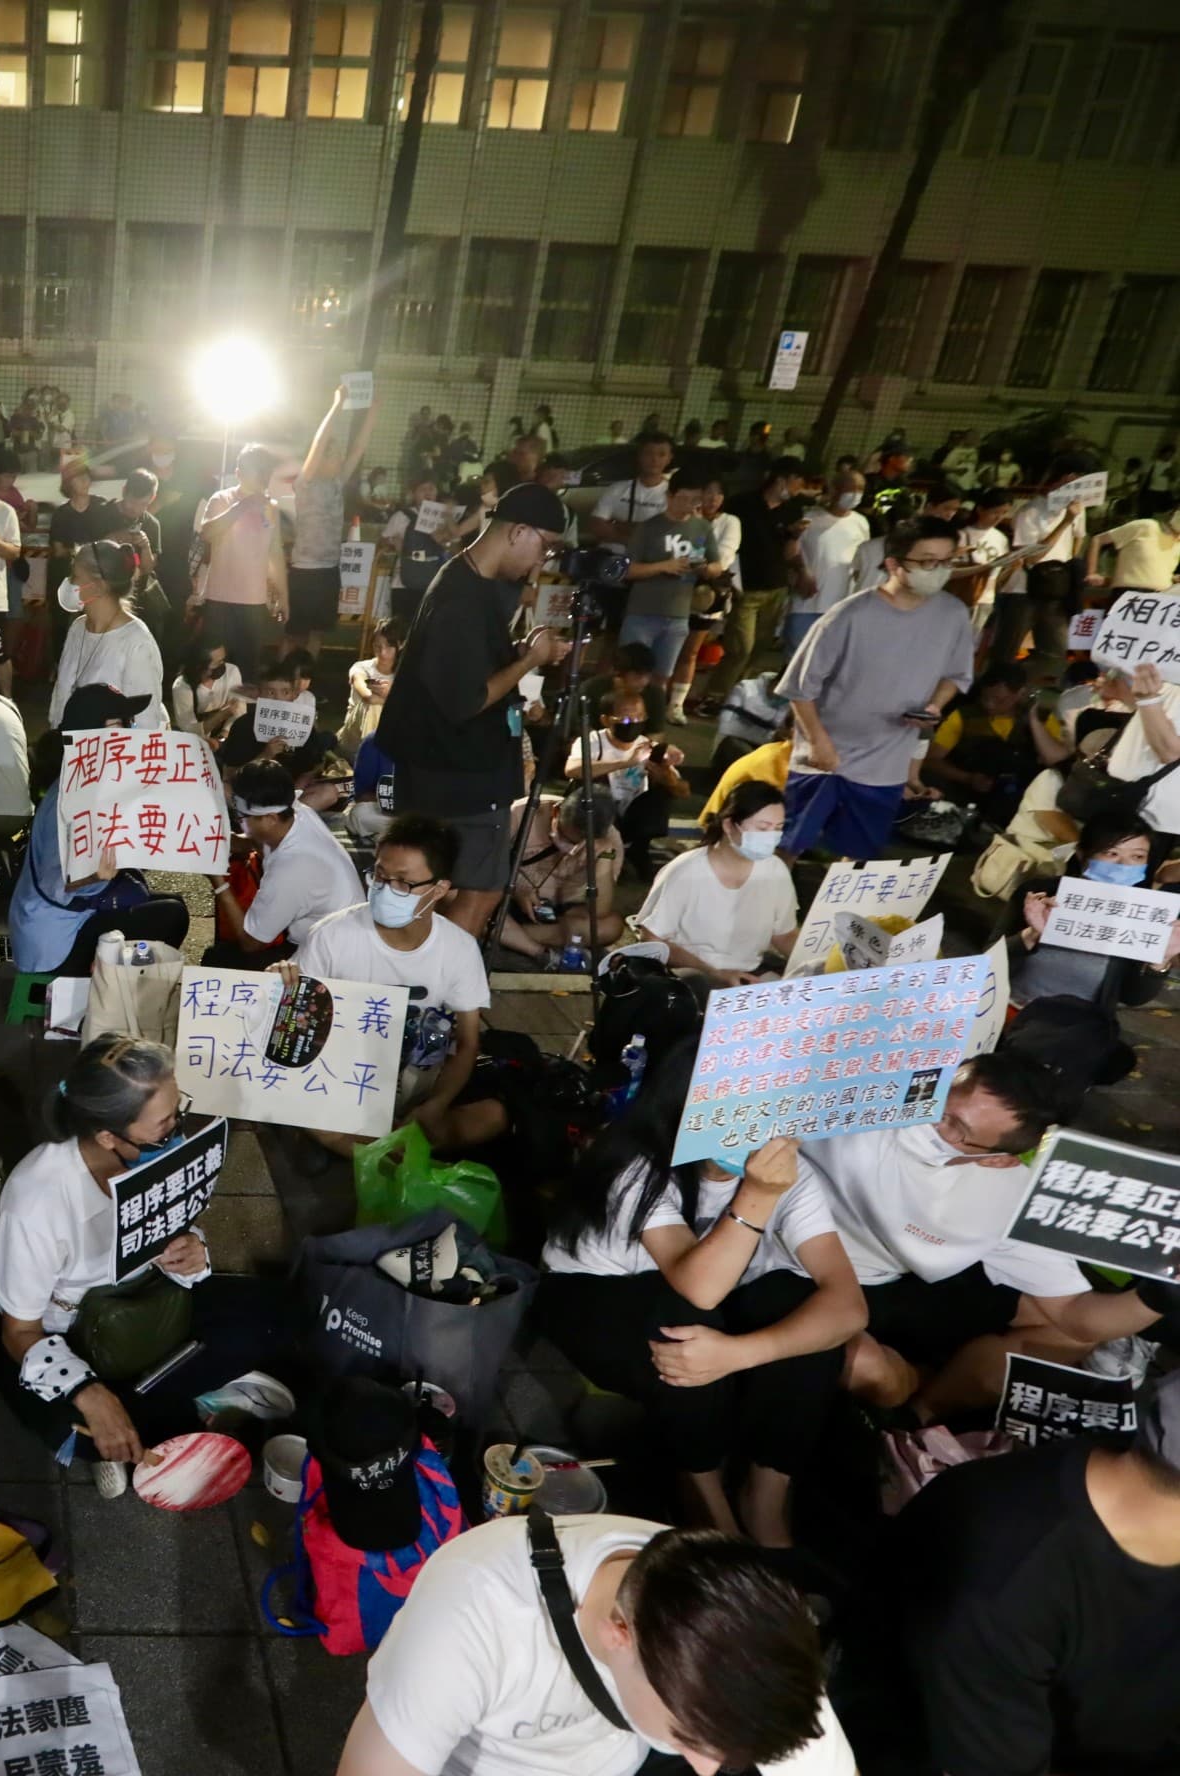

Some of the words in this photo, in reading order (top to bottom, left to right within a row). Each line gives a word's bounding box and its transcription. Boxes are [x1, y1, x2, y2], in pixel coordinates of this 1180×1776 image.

[258, 724, 307, 739] 司法要公平
[260, 707, 310, 726] 程序要正義
[66, 732, 218, 793] 程序要正義
[73, 803, 228, 863] 司法要公平
[820, 868, 938, 904] 程序要正義
[1063, 893, 1170, 925] 程序要正義
[1054, 917, 1161, 949] 司法要公平
[188, 1036, 381, 1106] 司法要公平
[684, 1080, 900, 1132] 這是柯文哲的治國信念
[120, 1143, 223, 1229] 程序要正義
[1040, 1159, 1180, 1221] 程序要正
[121, 1175, 219, 1259] 司法要公平
[1024, 1193, 1180, 1255] 司法要公平
[342, 1319, 382, 1349] Promise
[345, 1306, 369, 1328] Keep
